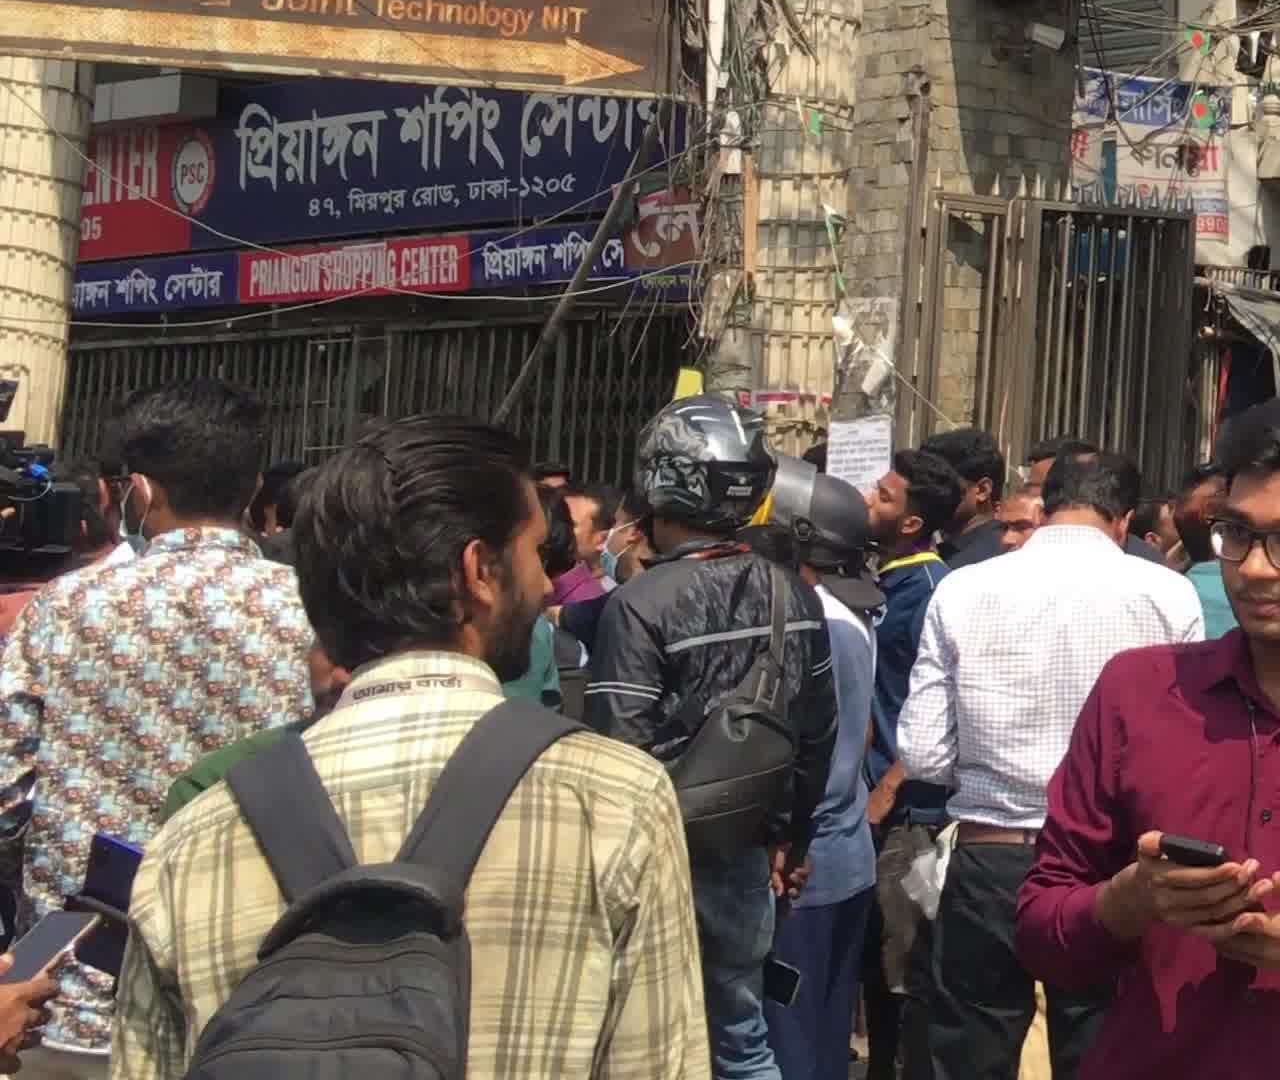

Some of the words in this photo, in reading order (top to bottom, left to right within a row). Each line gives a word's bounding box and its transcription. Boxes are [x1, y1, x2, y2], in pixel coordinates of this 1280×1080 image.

[540, 5, 589, 34] NIT
[233, 102, 387, 193] প্রিয়াঙ্গন
[397, 87, 504, 172] শপিং
[180, 158, 207, 185] PSC
[466, 173, 577, 202] ঢাকা-১২০৫
[163, 264, 224, 304] সেন্টার
[322, 248, 397, 292] SHOPPING
[400, 243, 459, 287] CENTER
